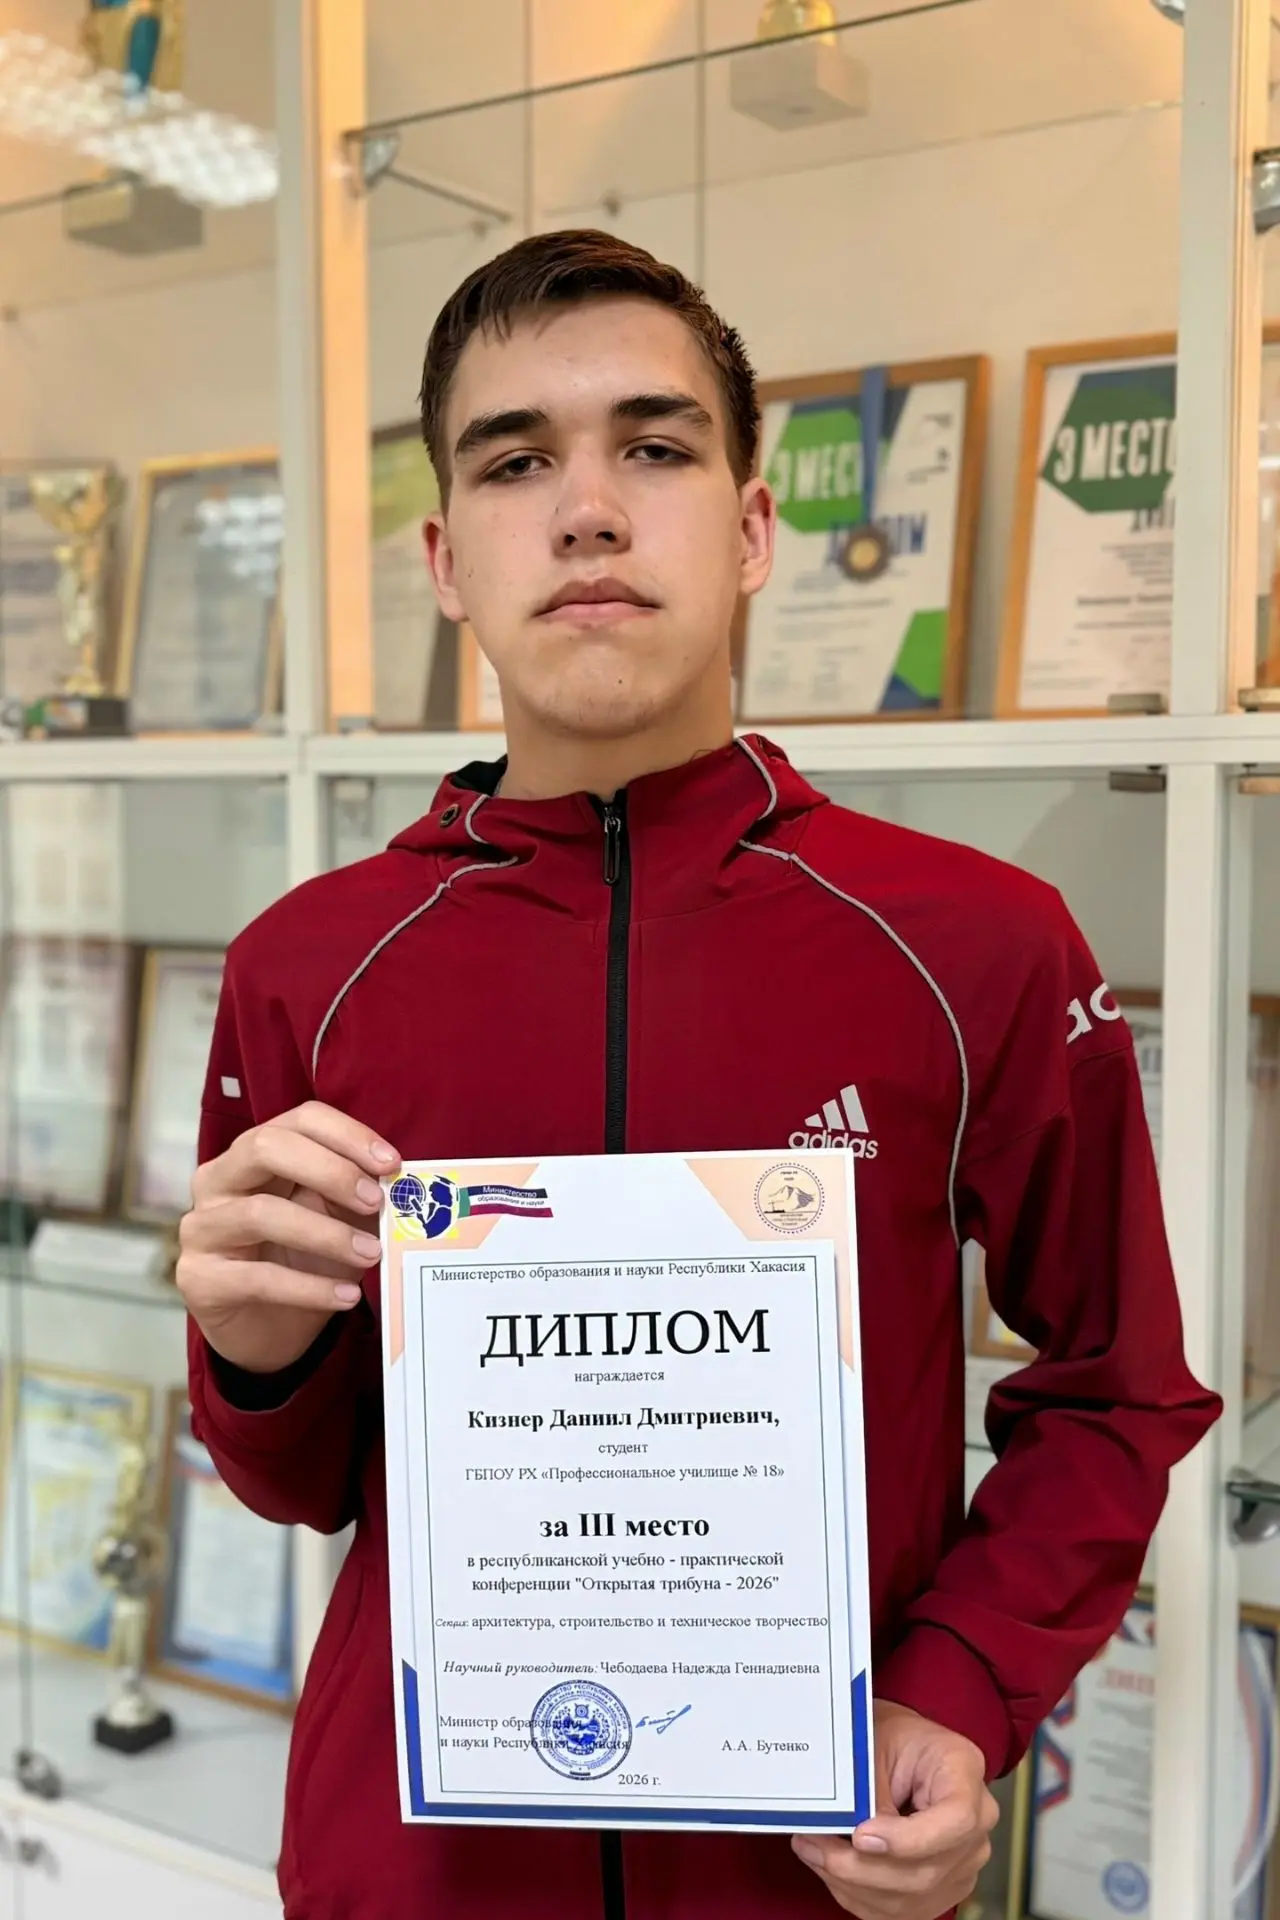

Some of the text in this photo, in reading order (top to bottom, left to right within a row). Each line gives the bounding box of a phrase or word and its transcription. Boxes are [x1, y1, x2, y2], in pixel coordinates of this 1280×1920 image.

[1054, 426, 1077, 484] 3
[788, 1129, 879, 1159] adidas
[482, 1185, 537, 1198] Министерство
[431, 1261, 806, 1283] Министерство образования и науки Республики Хакасия
[479, 1308, 771, 1368] ДИПЛОМ
[574, 1371, 665, 1386] награждается
[467, 1407, 780, 1433] Кизнер Даниил Дмитриевич,
[597, 1443, 649, 1458] студент
[465, 1464, 785, 1483] ГБПОУ РХ «Профессиональное училище № 18»
[539, 1512, 710, 1538] за III место
[467, 1556, 476, 1568] в
[479, 1552, 609, 1571] республиканской
[612, 1552, 666, 1570] учебно
[680, 1551, 784, 1570] практической
[471, 1576, 571, 1595] конференции
[575, 1576, 656, 1594] "Открытая
[659, 1575, 722, 1594] трибуна
[736, 1575, 780, 1590] 2026"
[471, 1616, 556, 1631] архитектура,
[559, 1616, 654, 1631] строительство
[657, 1617, 666, 1628] и
[669, 1617, 752, 1628] техническое
[755, 1616, 829, 1630] творчество
[443, 1660, 821, 1677] Научный руководитель: Чебодаева Надежда Геннадиевна
[439, 1715, 499, 1731] Министр
[440, 1738, 449, 1748] и
[451, 1738, 489, 1751] науки
[721, 1739, 810, 1755] А.А. Бутенко
[617, 1773, 661, 1786] 2026 г.
